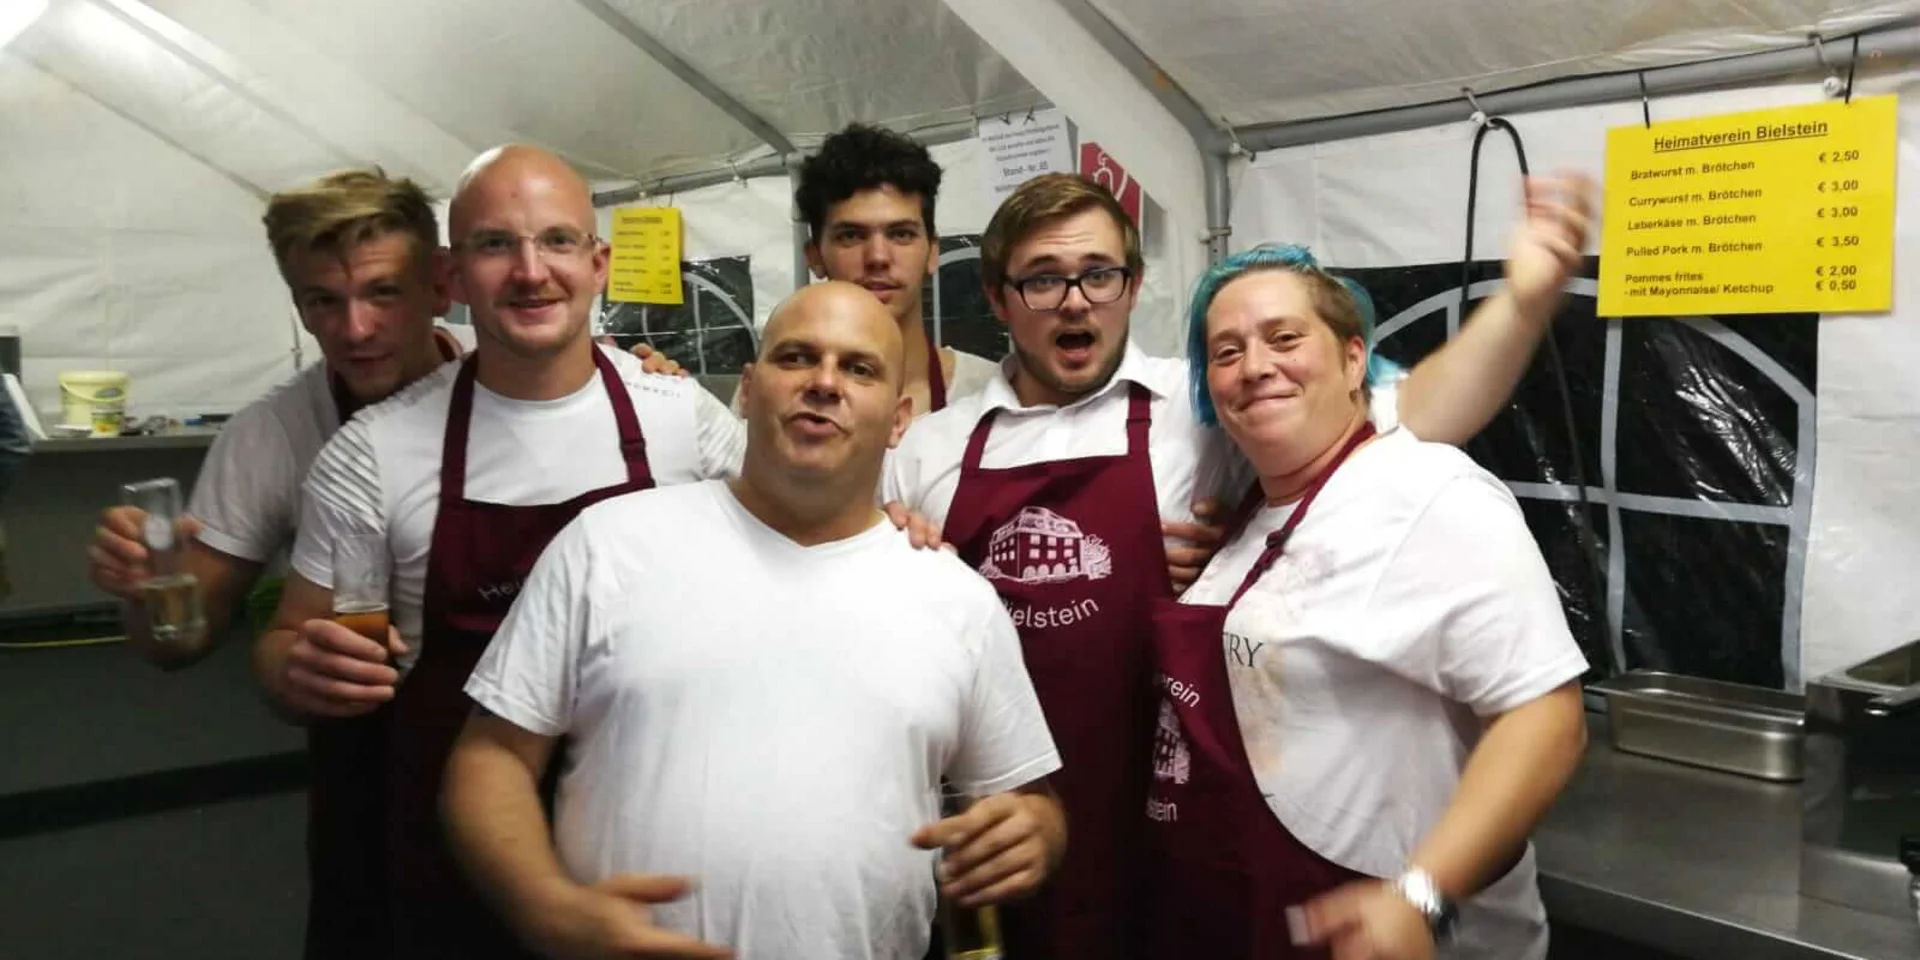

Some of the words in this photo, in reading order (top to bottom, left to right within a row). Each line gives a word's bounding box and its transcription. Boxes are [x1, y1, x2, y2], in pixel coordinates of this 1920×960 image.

[1653, 129, 1751, 151] Heimatverein
[1756, 120, 1828, 140] Bielstein
[1630, 166, 1683, 180] Bratwurst
[1702, 160, 1755, 174] Brötchen
[1818, 152, 1827, 163] €
[1628, 193, 1688, 208] Currywurst
[1708, 187, 1763, 201] Brötchen
[1817, 181, 1826, 193] €
[1627, 216, 1683, 231] Leberkäse
[1702, 213, 1757, 226] Brötchen
[1816, 207, 1825, 219] €
[1625, 244, 1660, 257] Pulled
[1662, 243, 1688, 256] Pork
[1708, 240, 1763, 253] Brötchen
[1815, 236, 1825, 248] €
[1625, 272, 1672, 284] Pommes
[1674, 271, 1704, 283] frites
[1815, 265, 1825, 277] €
[1723, 283, 1774, 297] Ketchup
[1815, 280, 1825, 292] €
